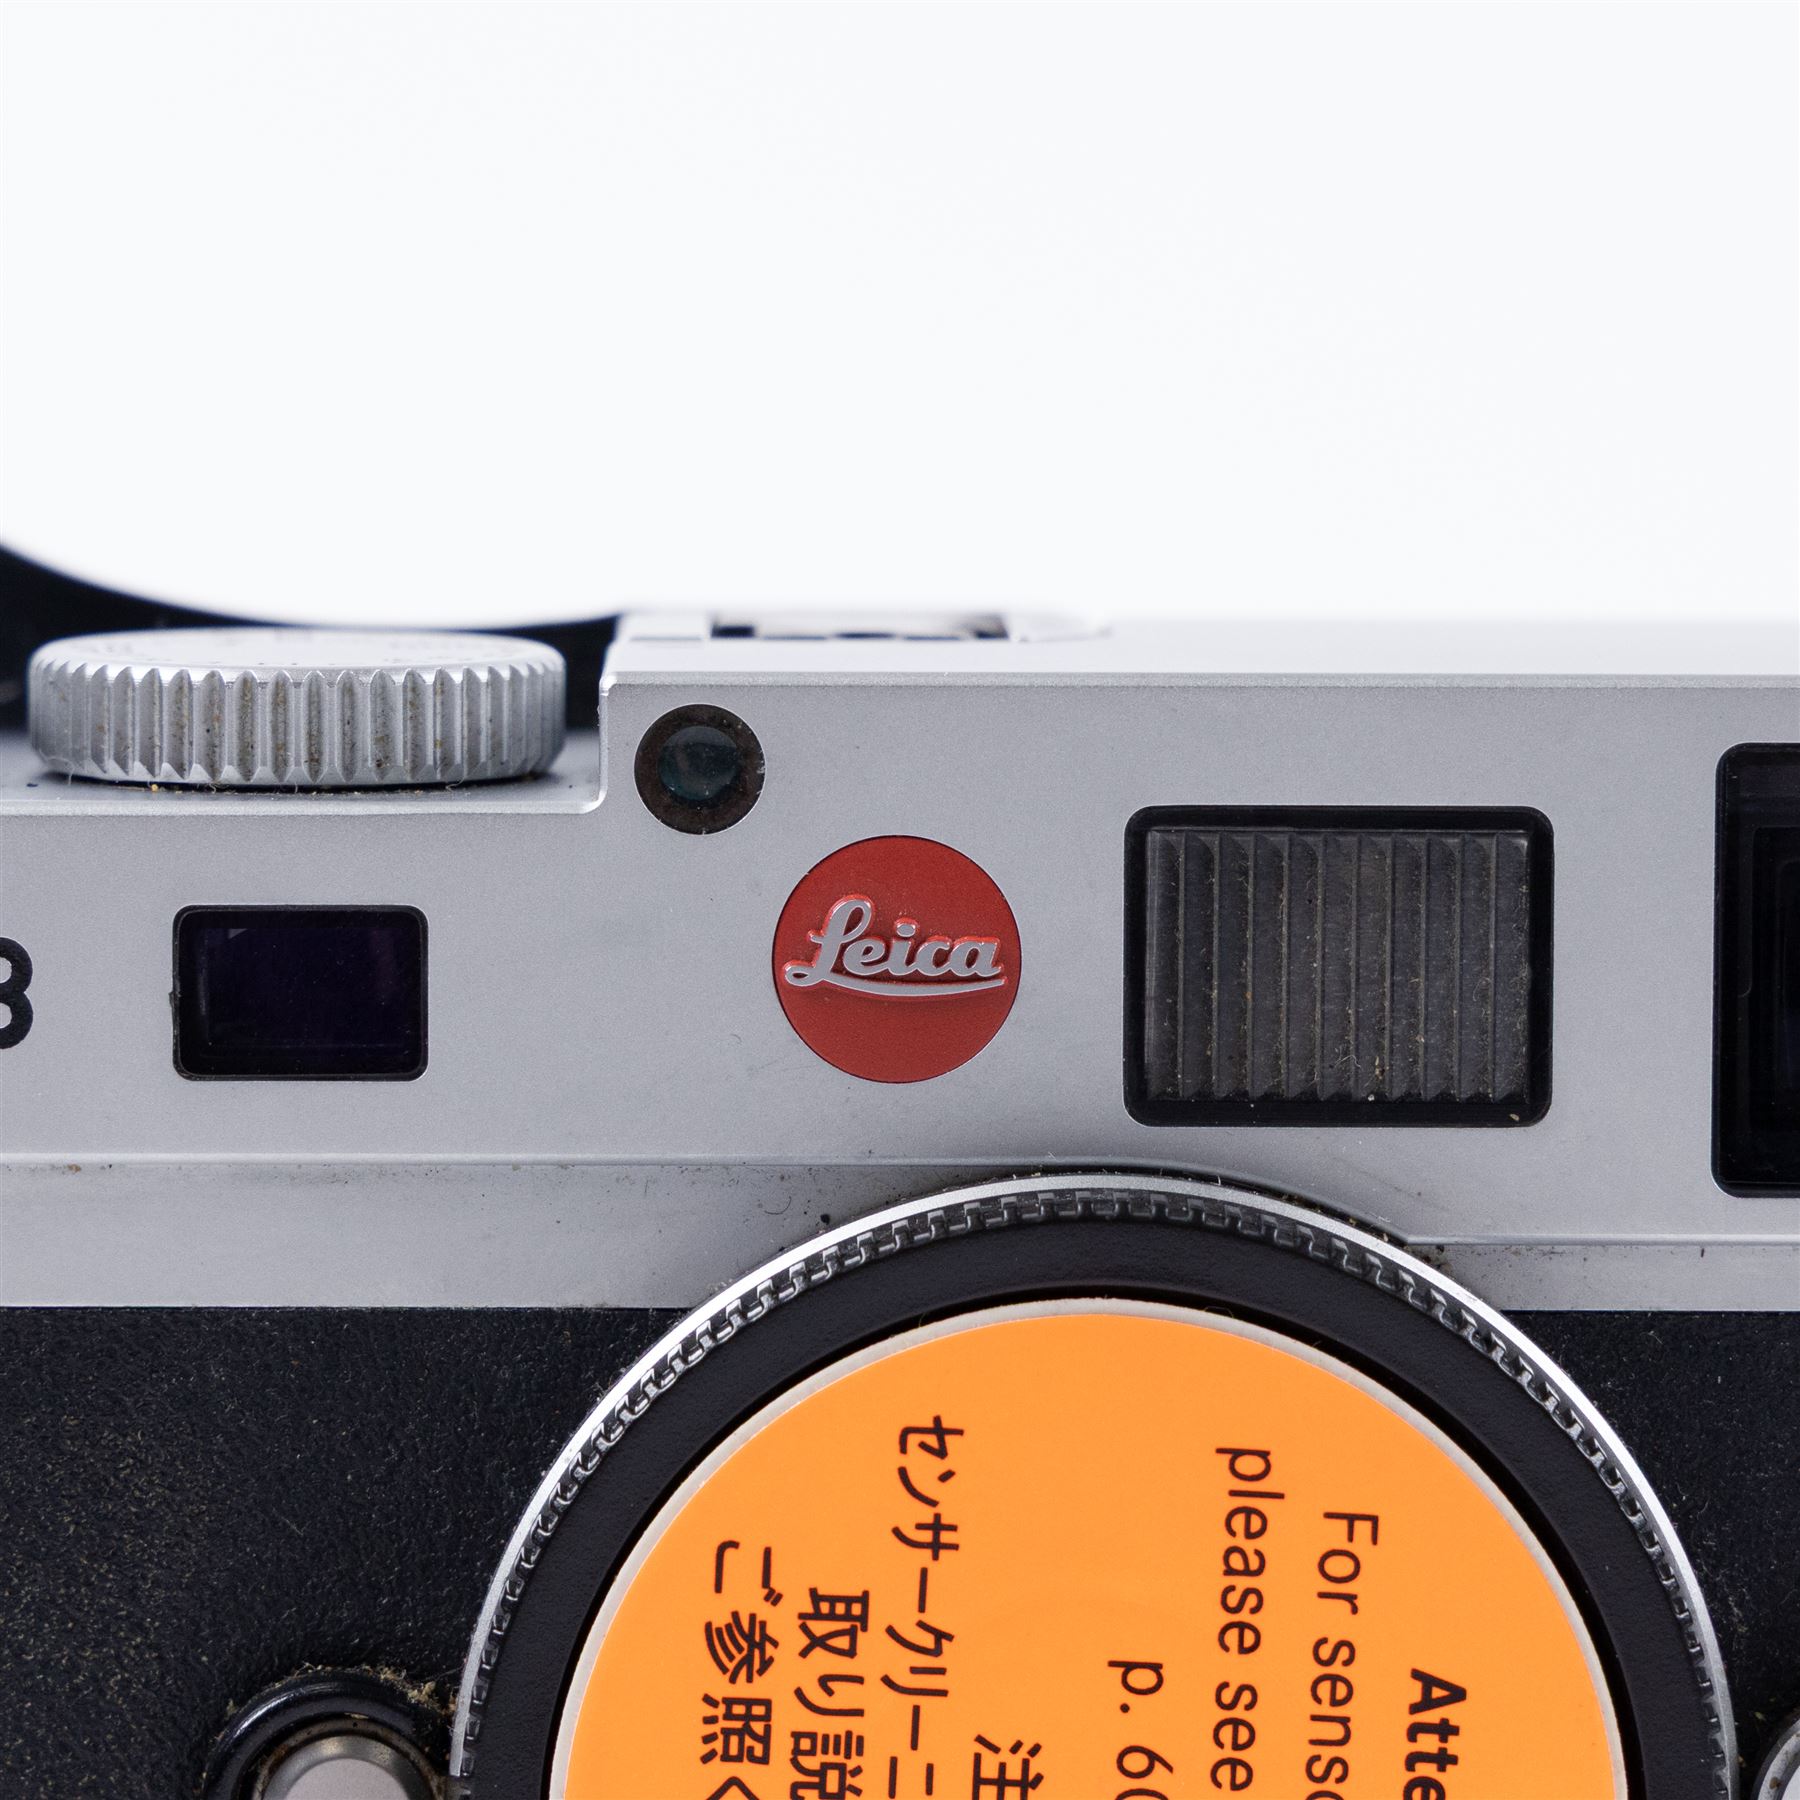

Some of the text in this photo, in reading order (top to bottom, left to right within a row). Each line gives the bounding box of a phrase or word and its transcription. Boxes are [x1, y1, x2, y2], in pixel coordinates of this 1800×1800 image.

[785, 894, 1007, 997] Leica
[1107, 1660, 1164, 1714] p.
[1210, 1447, 1285, 1792] please see
[1305, 1512, 1379, 1800] For sens
